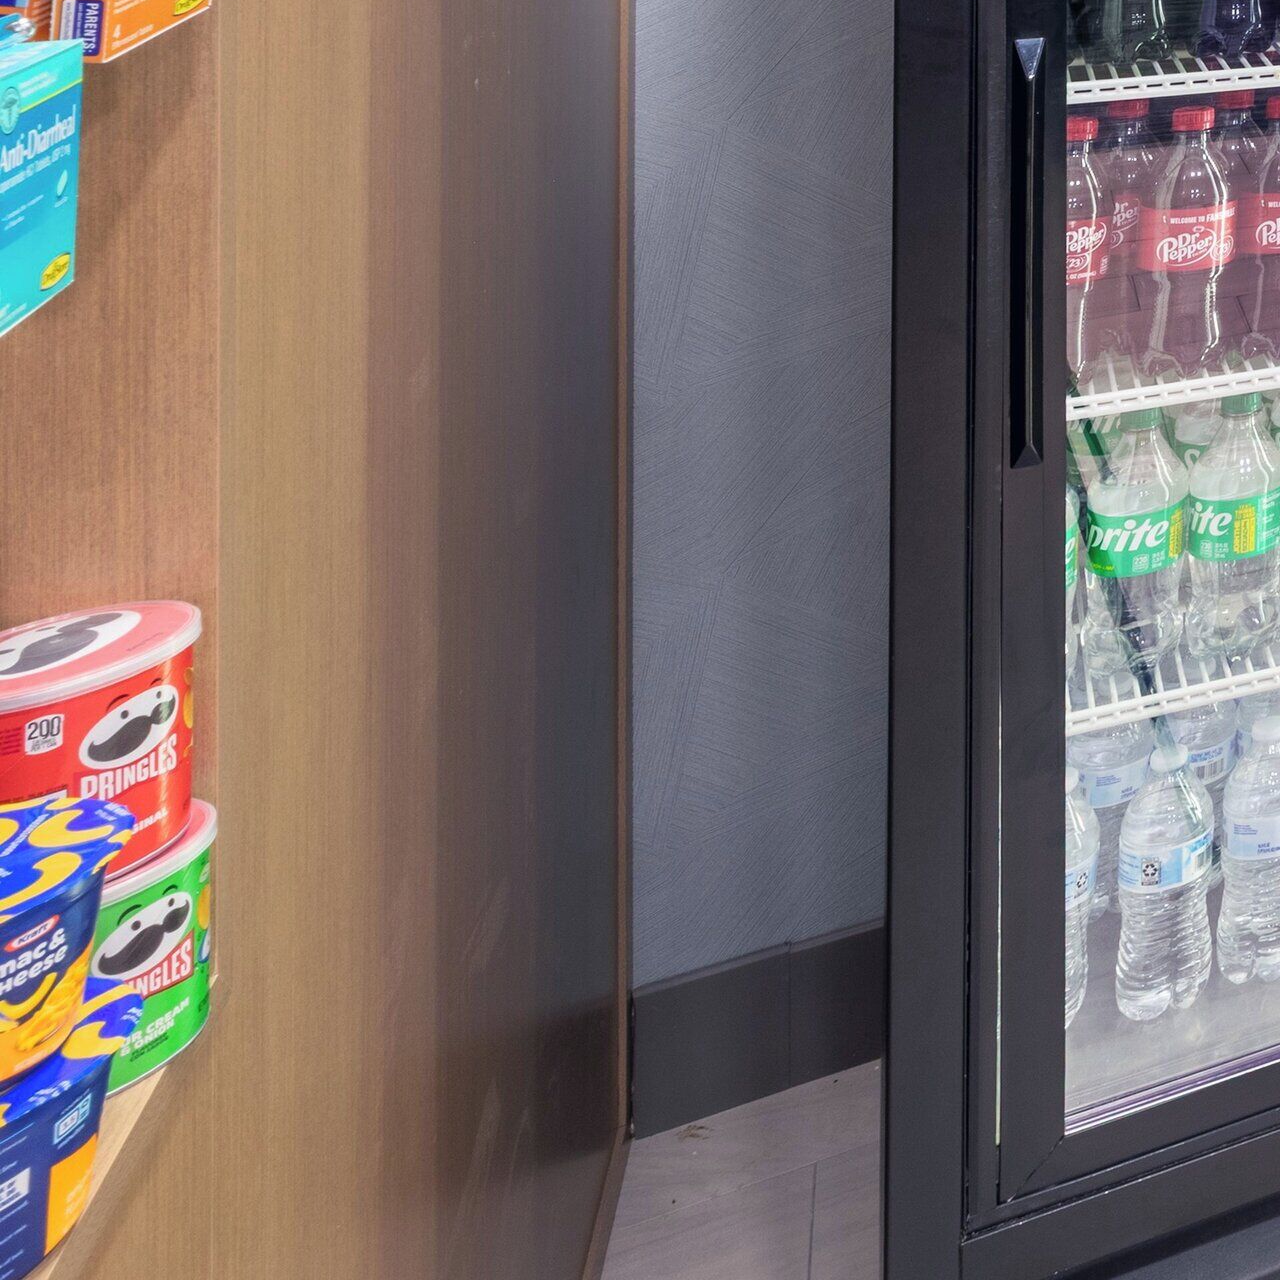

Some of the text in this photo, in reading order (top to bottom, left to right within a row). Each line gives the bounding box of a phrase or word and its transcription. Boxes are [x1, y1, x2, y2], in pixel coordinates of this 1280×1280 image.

[1170, 215, 1197, 224] WELCOME
[1078, 225, 1096, 239] Dr
[1177, 231, 1200, 249] Dr
[1161, 234, 1213, 263] Pepper
[27, 716, 61, 741] 200
[80, 733, 178, 801] PRINGLES
[18, 922, 49, 945] Kraft
[146, 997, 190, 1033] CREAM
